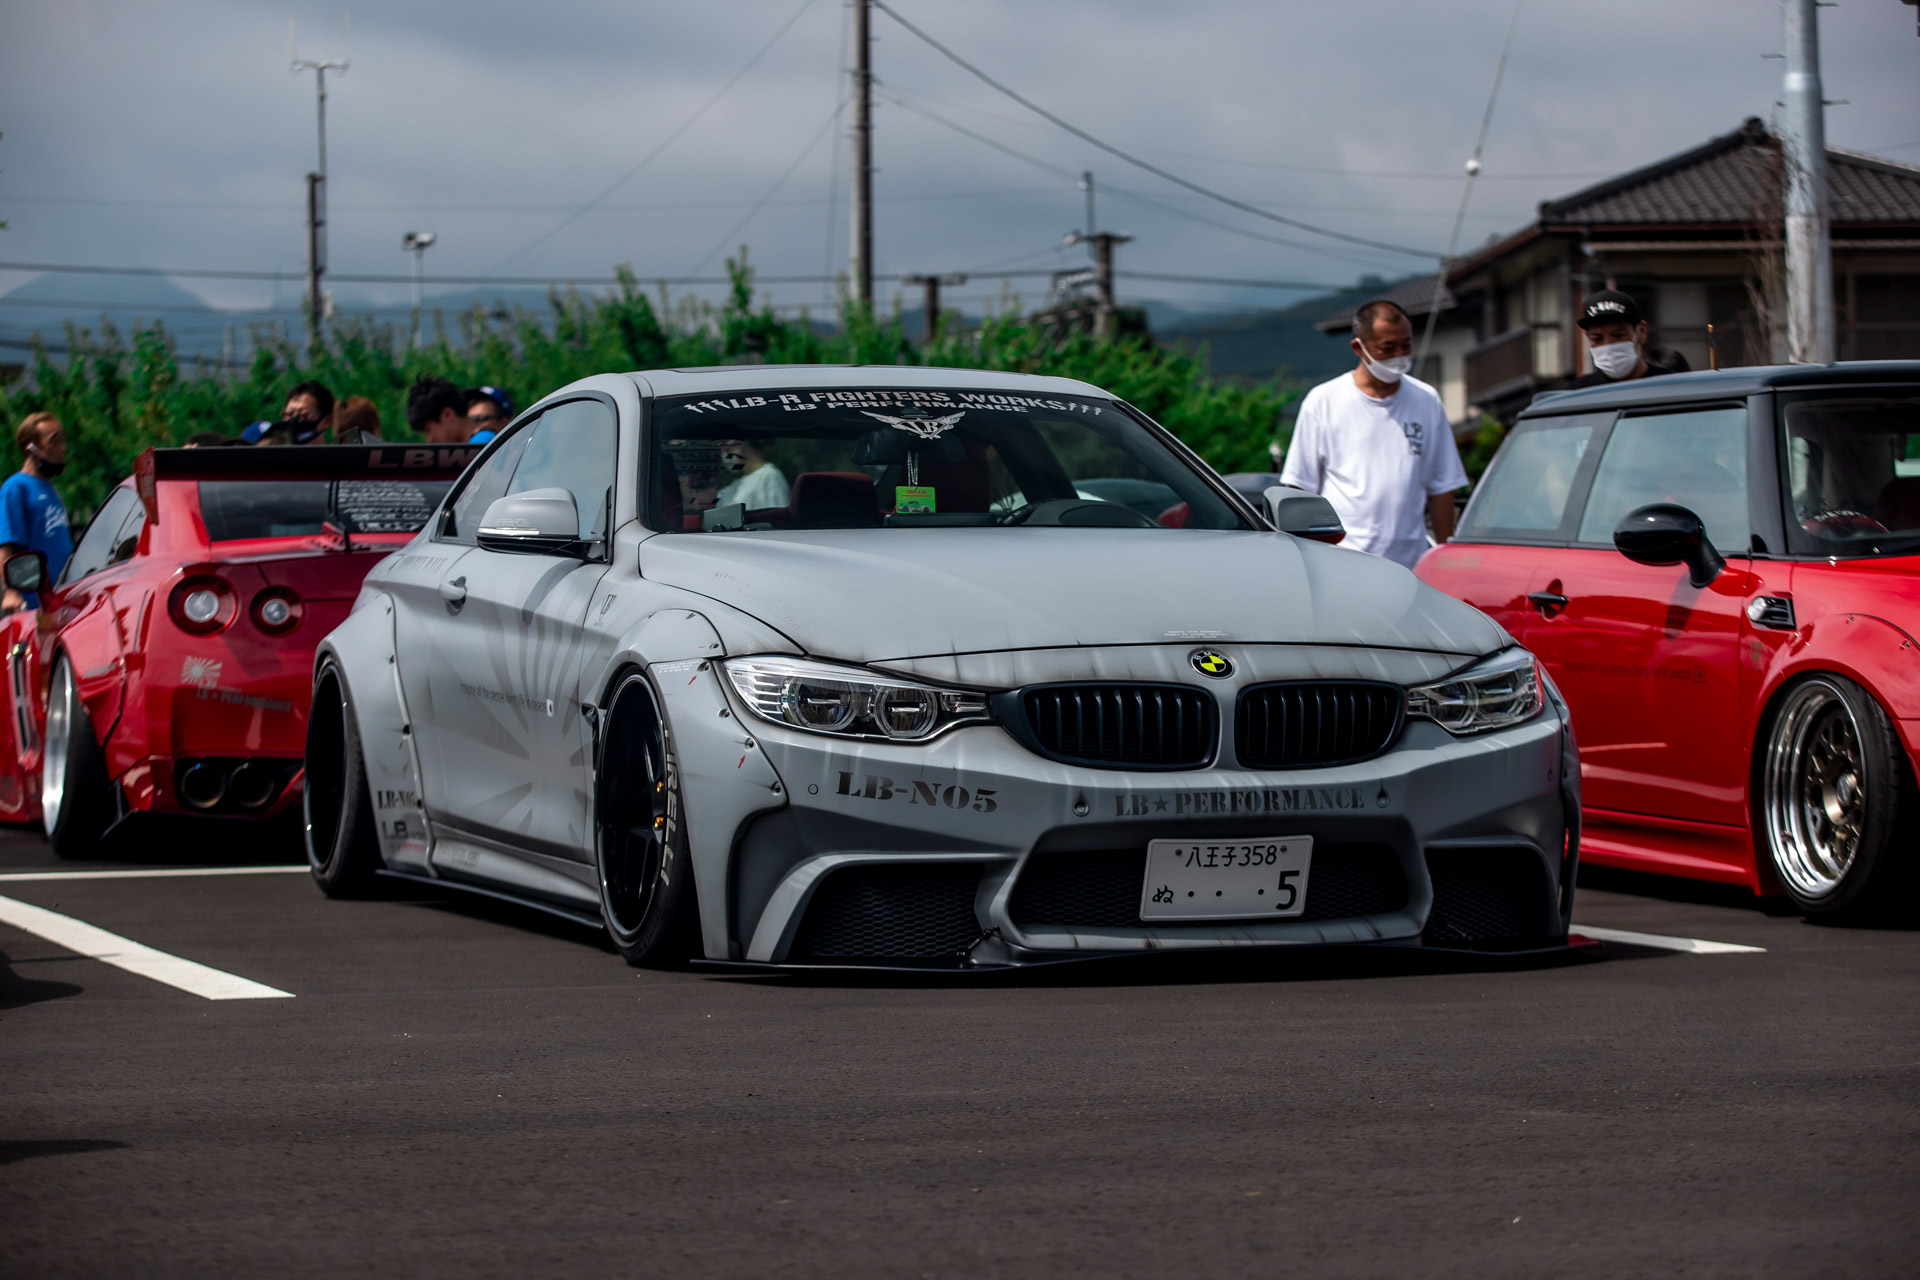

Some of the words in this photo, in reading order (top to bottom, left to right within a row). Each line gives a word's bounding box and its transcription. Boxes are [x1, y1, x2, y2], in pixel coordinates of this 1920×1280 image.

[783, 403, 818, 412] LB
[809, 391, 951, 403] FIGHTERS
[957, 393, 1067, 411] WORKS
[1174, 787, 1365, 815] PERFORMANCE
[1152, 884, 1174, 904] ぬ
